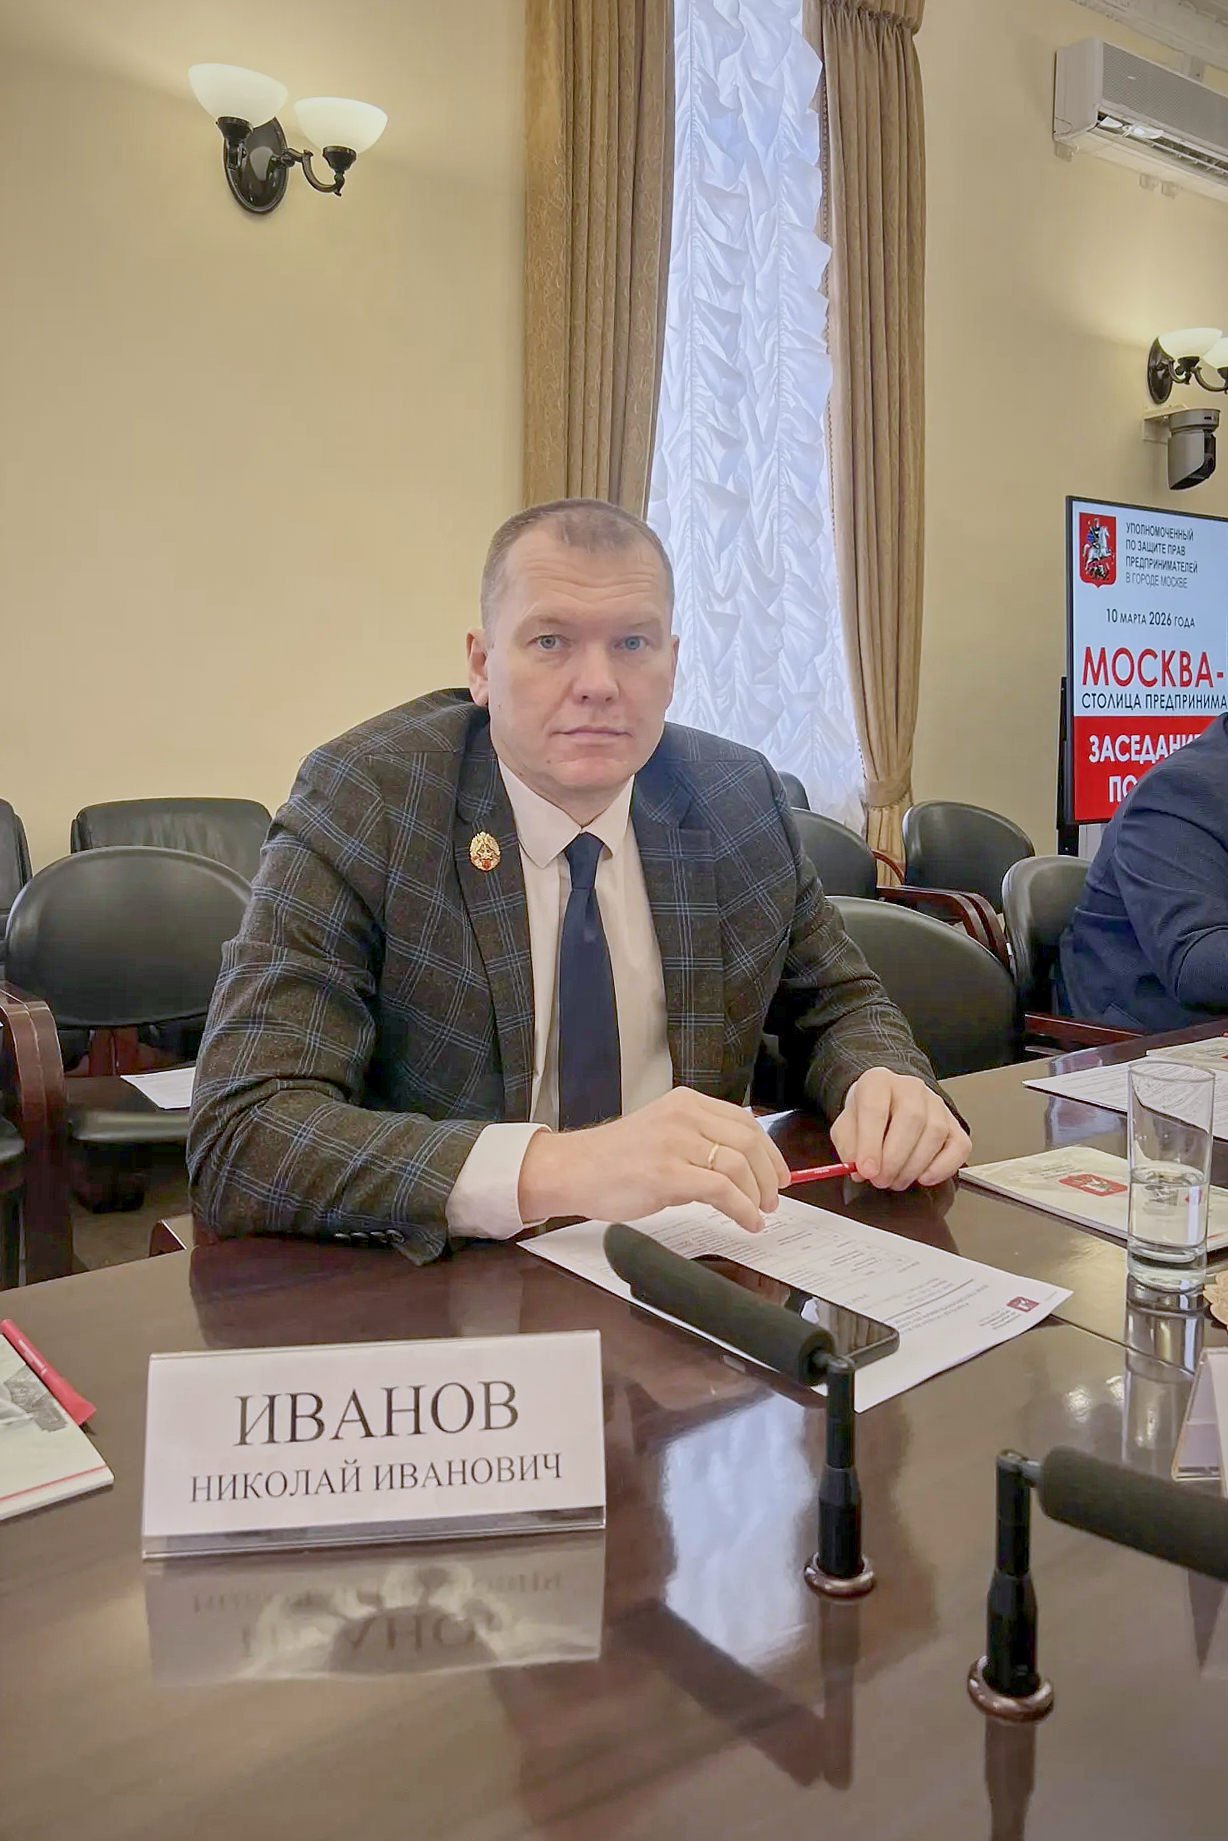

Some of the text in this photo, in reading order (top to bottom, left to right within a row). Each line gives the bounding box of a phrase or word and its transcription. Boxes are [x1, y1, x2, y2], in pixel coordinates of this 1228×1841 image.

[1126, 522, 1194, 541] УПОЛНОМОЧЕННЫЙ
[1126, 539, 1186, 556] ПО ЗАЩИТЕ ПРАВ
[1126, 555, 1198, 573] ПРЕДПРИНИМАТЕЛЕЙ
[1126, 572, 1188, 589] В ГОРОДЕ МОСКВЕ
[1106, 608, 1196, 628] 10 МАРТА 2026 ГОДА
[1082, 646, 1224, 688] МОСКВА-
[1081, 692, 1142, 711] СТОЛИЦА
[1088, 734, 1201, 765] ЗАСЕДАН
[234, 1380, 519, 1446] ИВАНОВ
[191, 1452, 562, 1502] НИКОЛАЙ ИВАНОВИЧ
